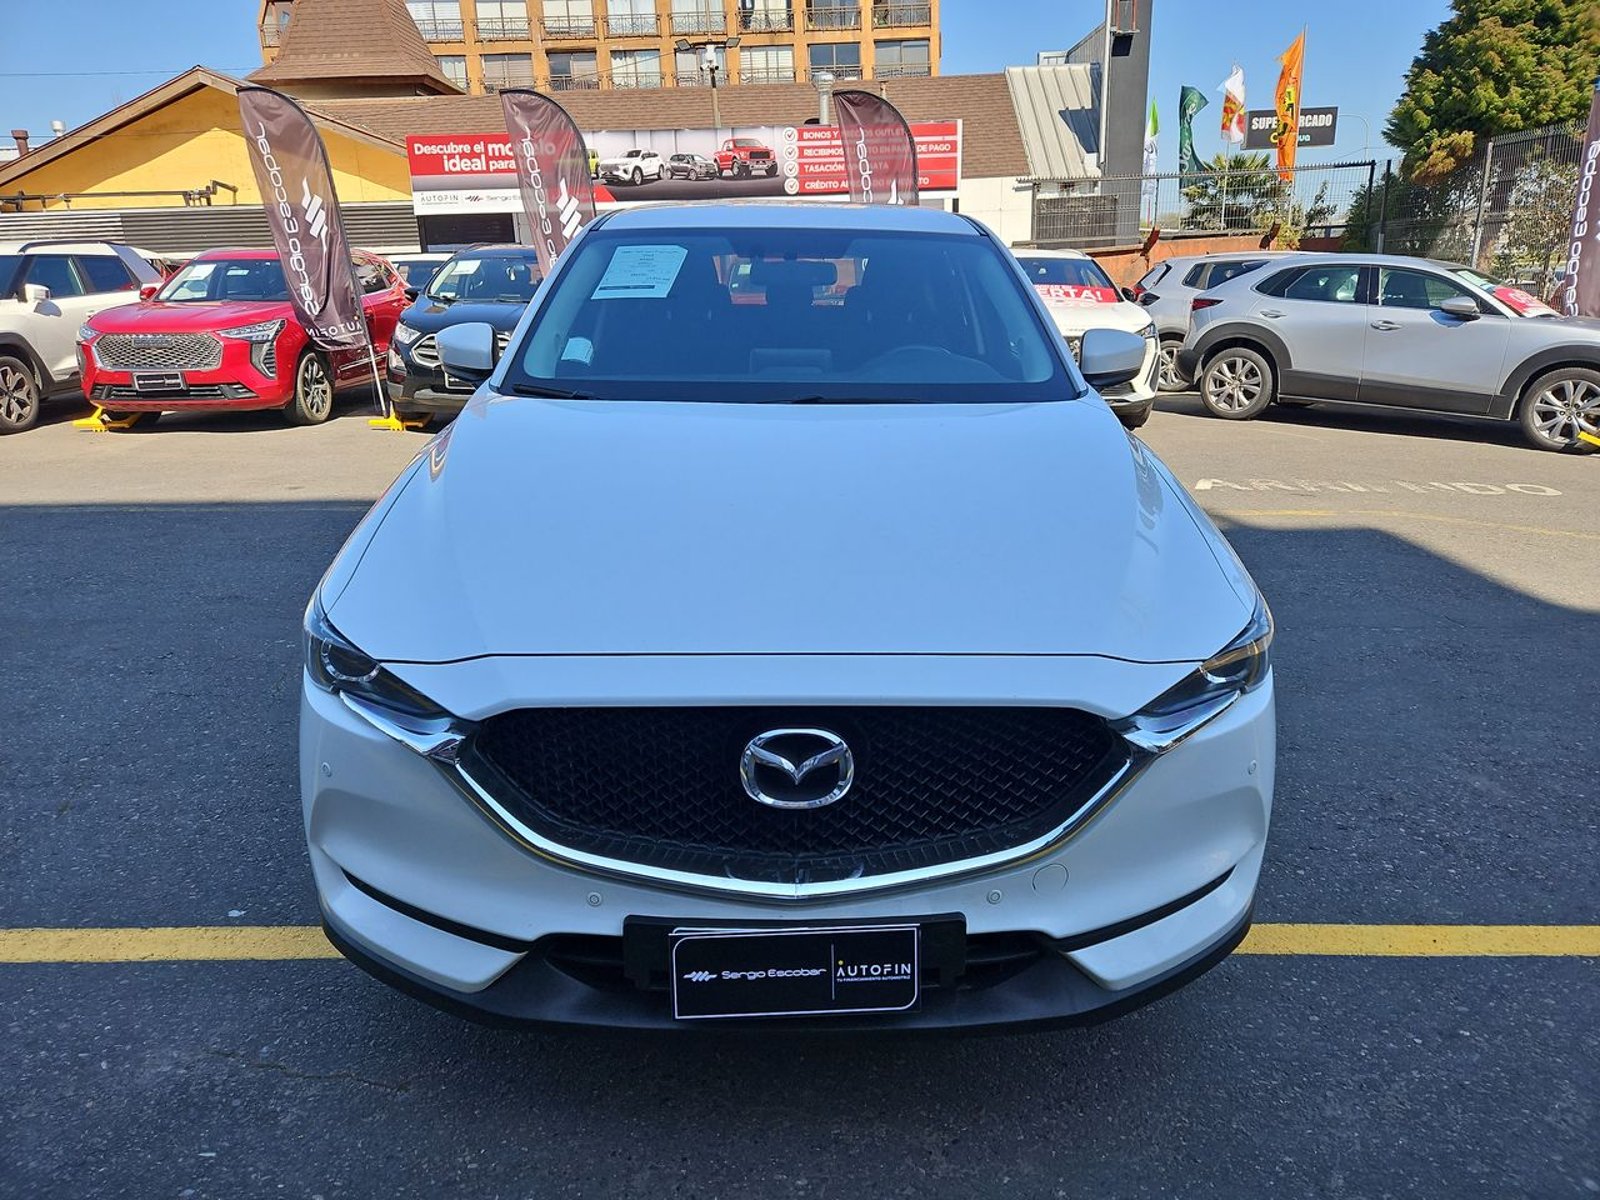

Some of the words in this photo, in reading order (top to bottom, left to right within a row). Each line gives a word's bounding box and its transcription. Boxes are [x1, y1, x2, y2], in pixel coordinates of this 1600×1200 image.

[1251, 114, 1332, 130] SUPERCADO
[803, 131, 832, 139] BONOS
[832, 131, 839, 139] Y
[413, 142, 470, 156] Descubre
[473, 141, 484, 153] el
[803, 148, 844, 157] RECIBIMOS
[929, 143, 951, 152] PAGO
[443, 155, 486, 172] ideal
[489, 159, 516, 172] para
[804, 161, 845, 172] TASACIÓN
[805, 178, 839, 189] CRÉDITO
[1038, 288, 1103, 301] ERTA!
[768, 967, 827, 978] Escobar
[836, 960, 911, 977] AUTOFIN
